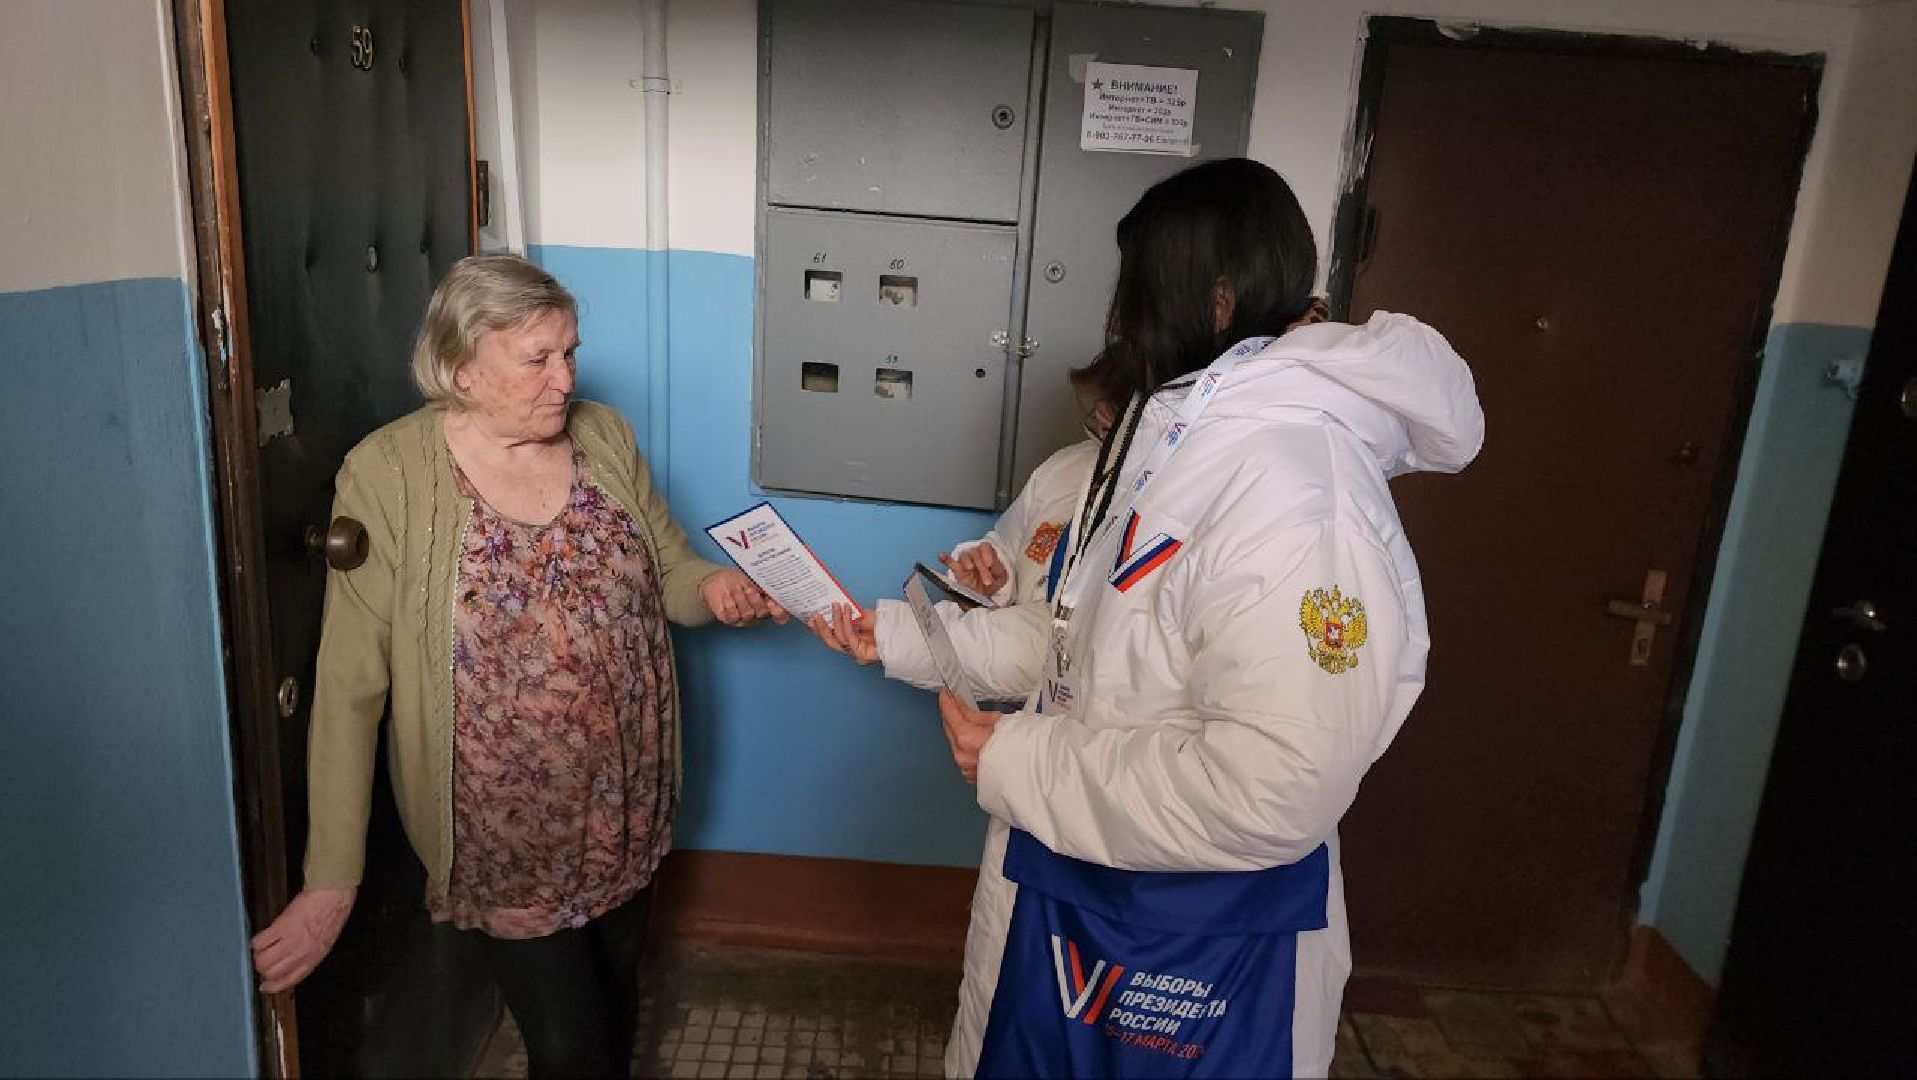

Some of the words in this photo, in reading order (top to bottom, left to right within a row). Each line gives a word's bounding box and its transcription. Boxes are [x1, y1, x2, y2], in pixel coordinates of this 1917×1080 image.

[351, 25, 373, 69] 59
[1110, 80, 1178, 95] ВНИМАНИЕ!
[890, 258, 905, 270] 60
[1130, 971, 1214, 998] ВЫБОРЫ
[1109, 1007, 1181, 1035] РОССИИ
